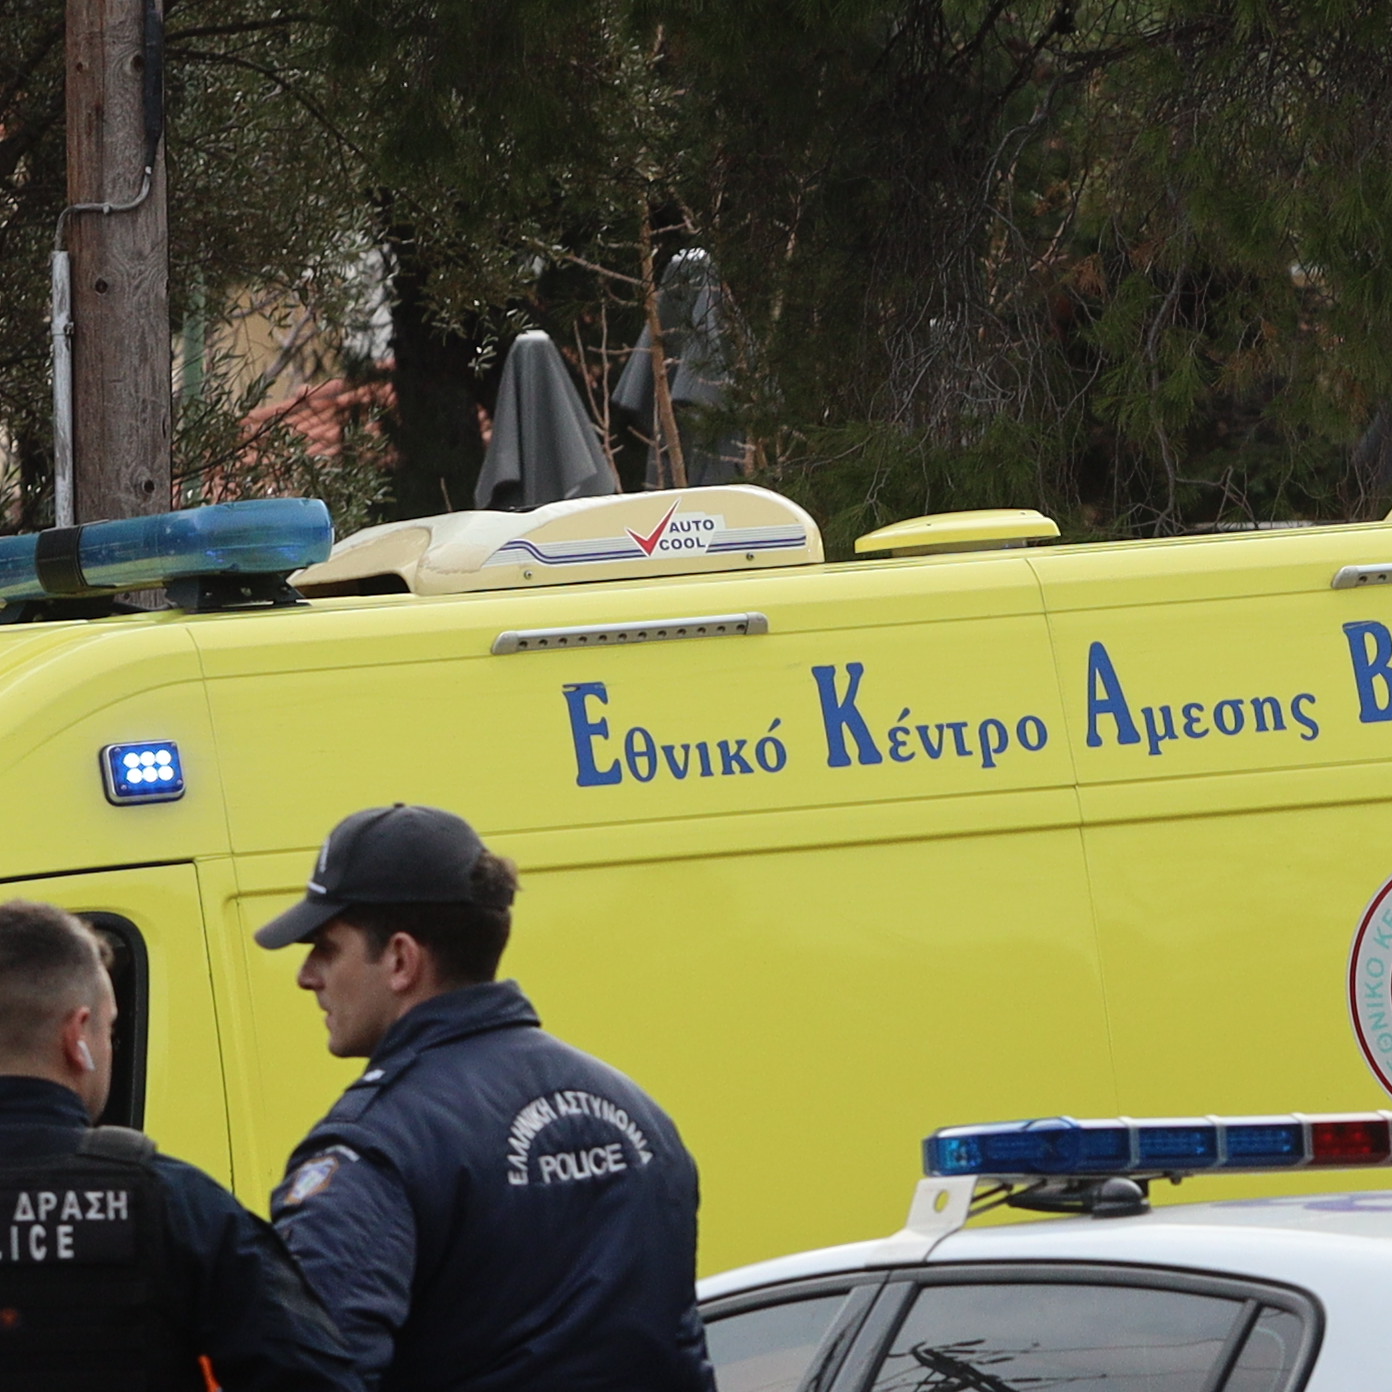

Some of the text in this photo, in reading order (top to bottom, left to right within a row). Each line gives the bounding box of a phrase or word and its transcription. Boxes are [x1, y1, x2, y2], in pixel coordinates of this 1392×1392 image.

[658, 536, 707, 551] COOL
[669, 518, 715, 534] AUTO
[561, 681, 787, 787] Εθνικό
[811, 661, 1048, 769] Κέντρο
[1083, 640, 1320, 755] Αμεσης
[554, 1090, 653, 1164] ΑΣΤΥΝΟΜΙΑ
[538, 1143, 627, 1184] POLICE
[13, 1190, 128, 1221] ΔΡΑΣΗ
[0, 1224, 75, 1261] ICE
